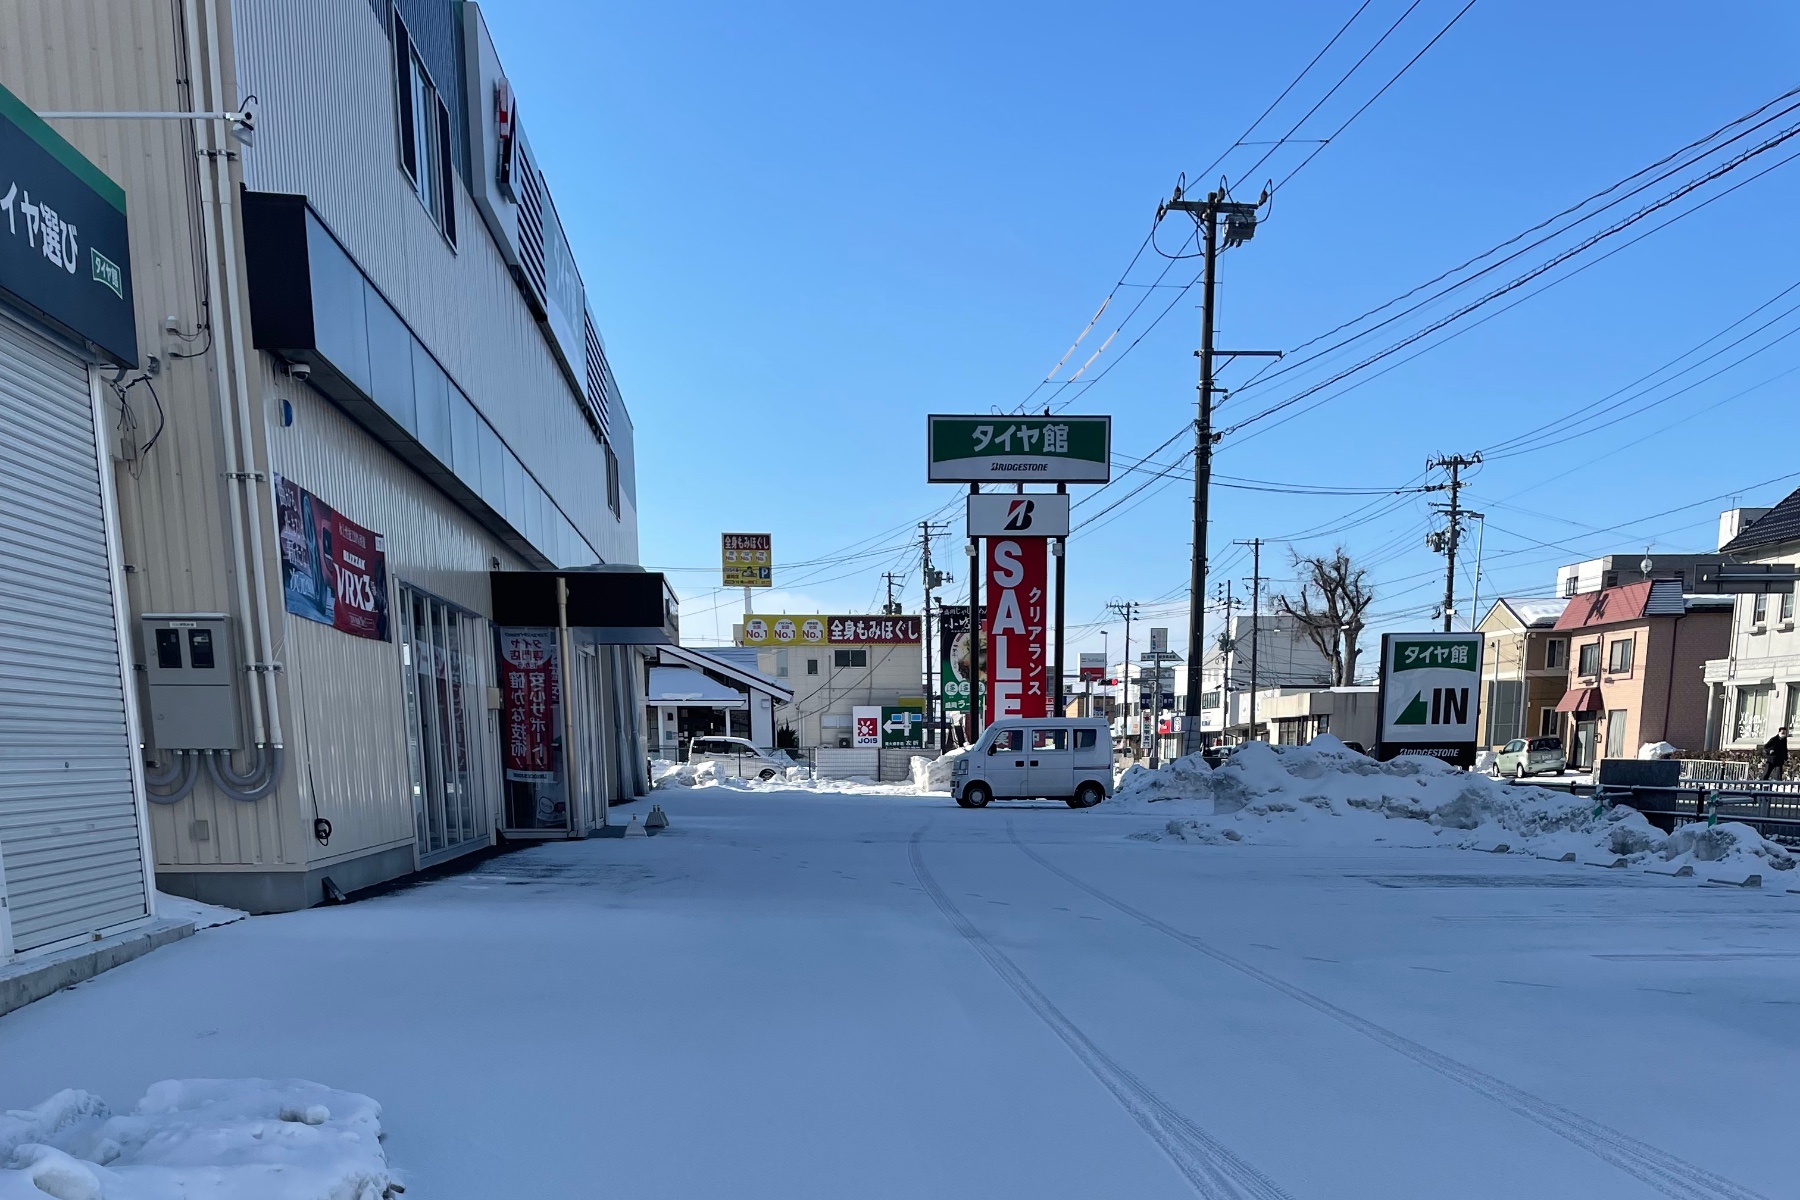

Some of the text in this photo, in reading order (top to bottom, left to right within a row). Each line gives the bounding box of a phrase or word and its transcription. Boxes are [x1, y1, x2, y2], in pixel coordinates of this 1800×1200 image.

[0, 181, 78, 274] イヤ選び
[95, 256, 119, 288] タイヤ館
[971, 423, 1069, 453] タイヤ館
[990, 462, 1049, 472] BRIDGESTONE
[724, 535, 770, 550] 全身もみほぐし
[332, 562, 375, 612] VRX3
[746, 629, 768, 639] No.1
[774, 629, 796, 639] No.1
[802, 629, 824, 639] No.1
[830, 619, 919, 640] 全身もみほぐし
[992, 540, 1027, 721] SALE
[1028, 586, 1043, 696] クリアランス
[1404, 644, 1469, 664] タイヤ館
[1431, 687, 1469, 725] IN
